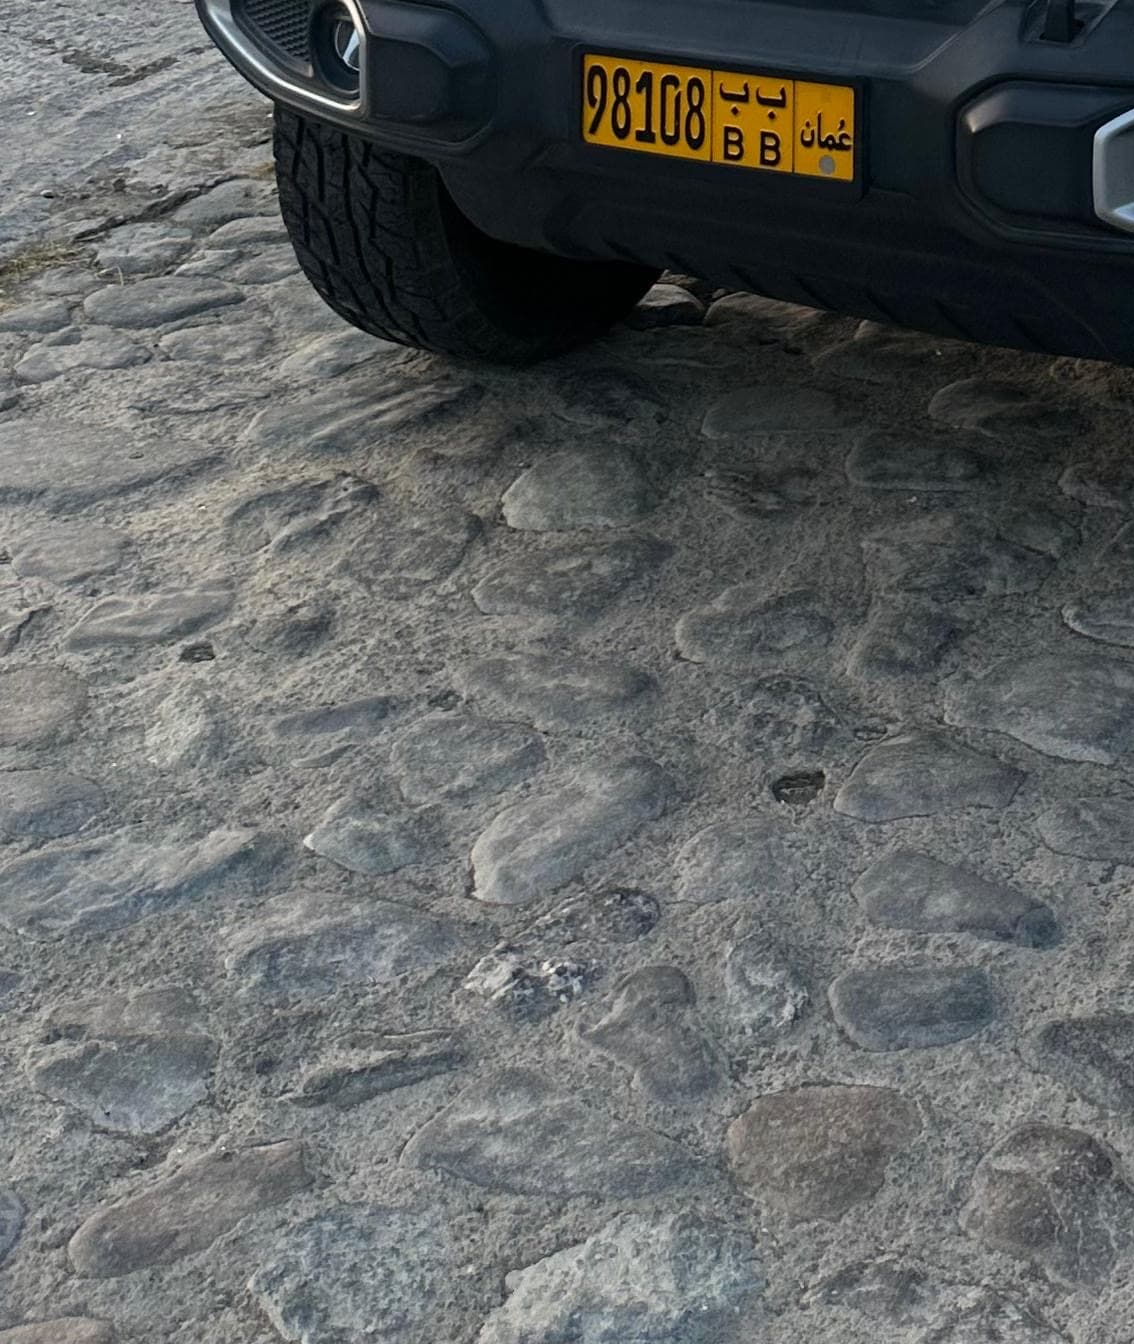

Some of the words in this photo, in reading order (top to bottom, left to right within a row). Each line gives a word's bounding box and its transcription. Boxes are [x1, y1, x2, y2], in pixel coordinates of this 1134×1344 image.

[587, 64, 705, 150] 98108
[719, 81, 750, 116] ب
[756, 86, 786, 120] ب
[723, 125, 745, 161] B
[759, 130, 781, 167] B
